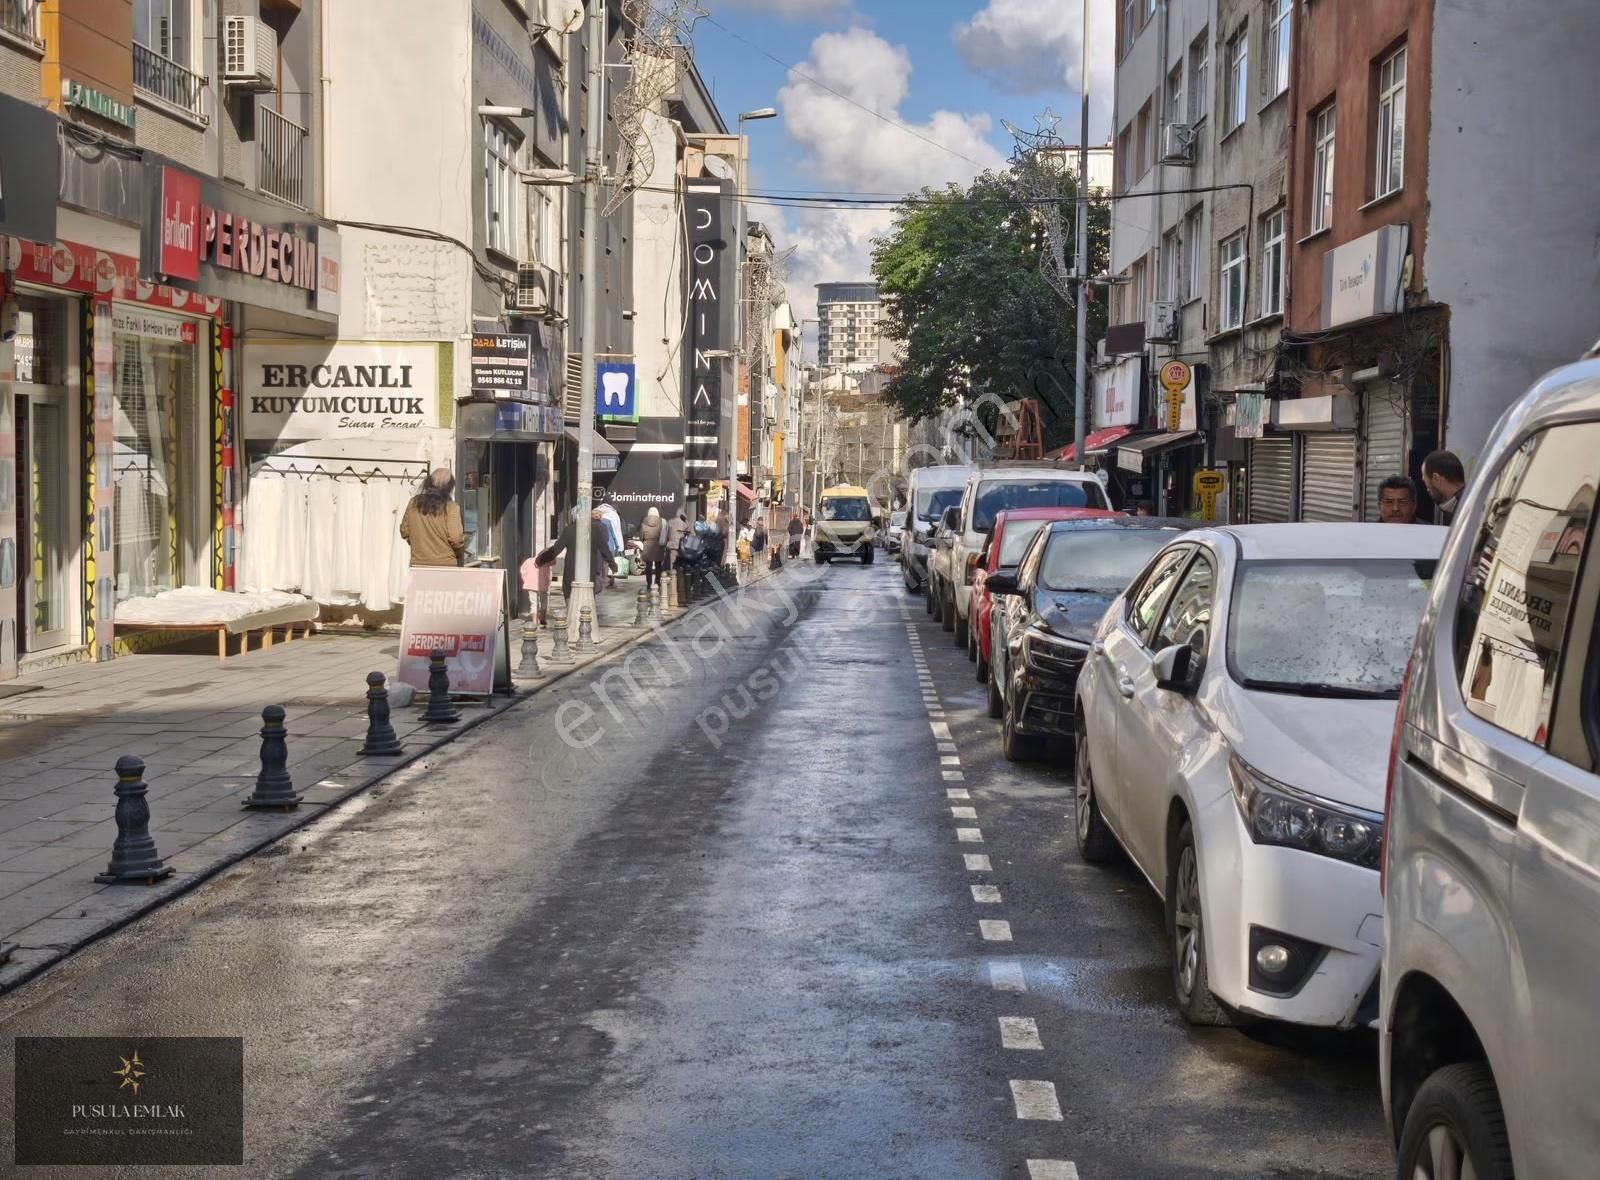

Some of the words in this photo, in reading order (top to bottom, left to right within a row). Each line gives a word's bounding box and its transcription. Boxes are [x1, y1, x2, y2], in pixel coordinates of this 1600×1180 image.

[689, 208, 717, 405] DOMINA
[473, 338, 495, 348] DARA
[496, 336, 526, 351] İLETİŞİM
[261, 364, 413, 388] ERCANLI
[251, 396, 424, 415] KUYUMCULUK
[338, 416, 375, 429] Sinan
